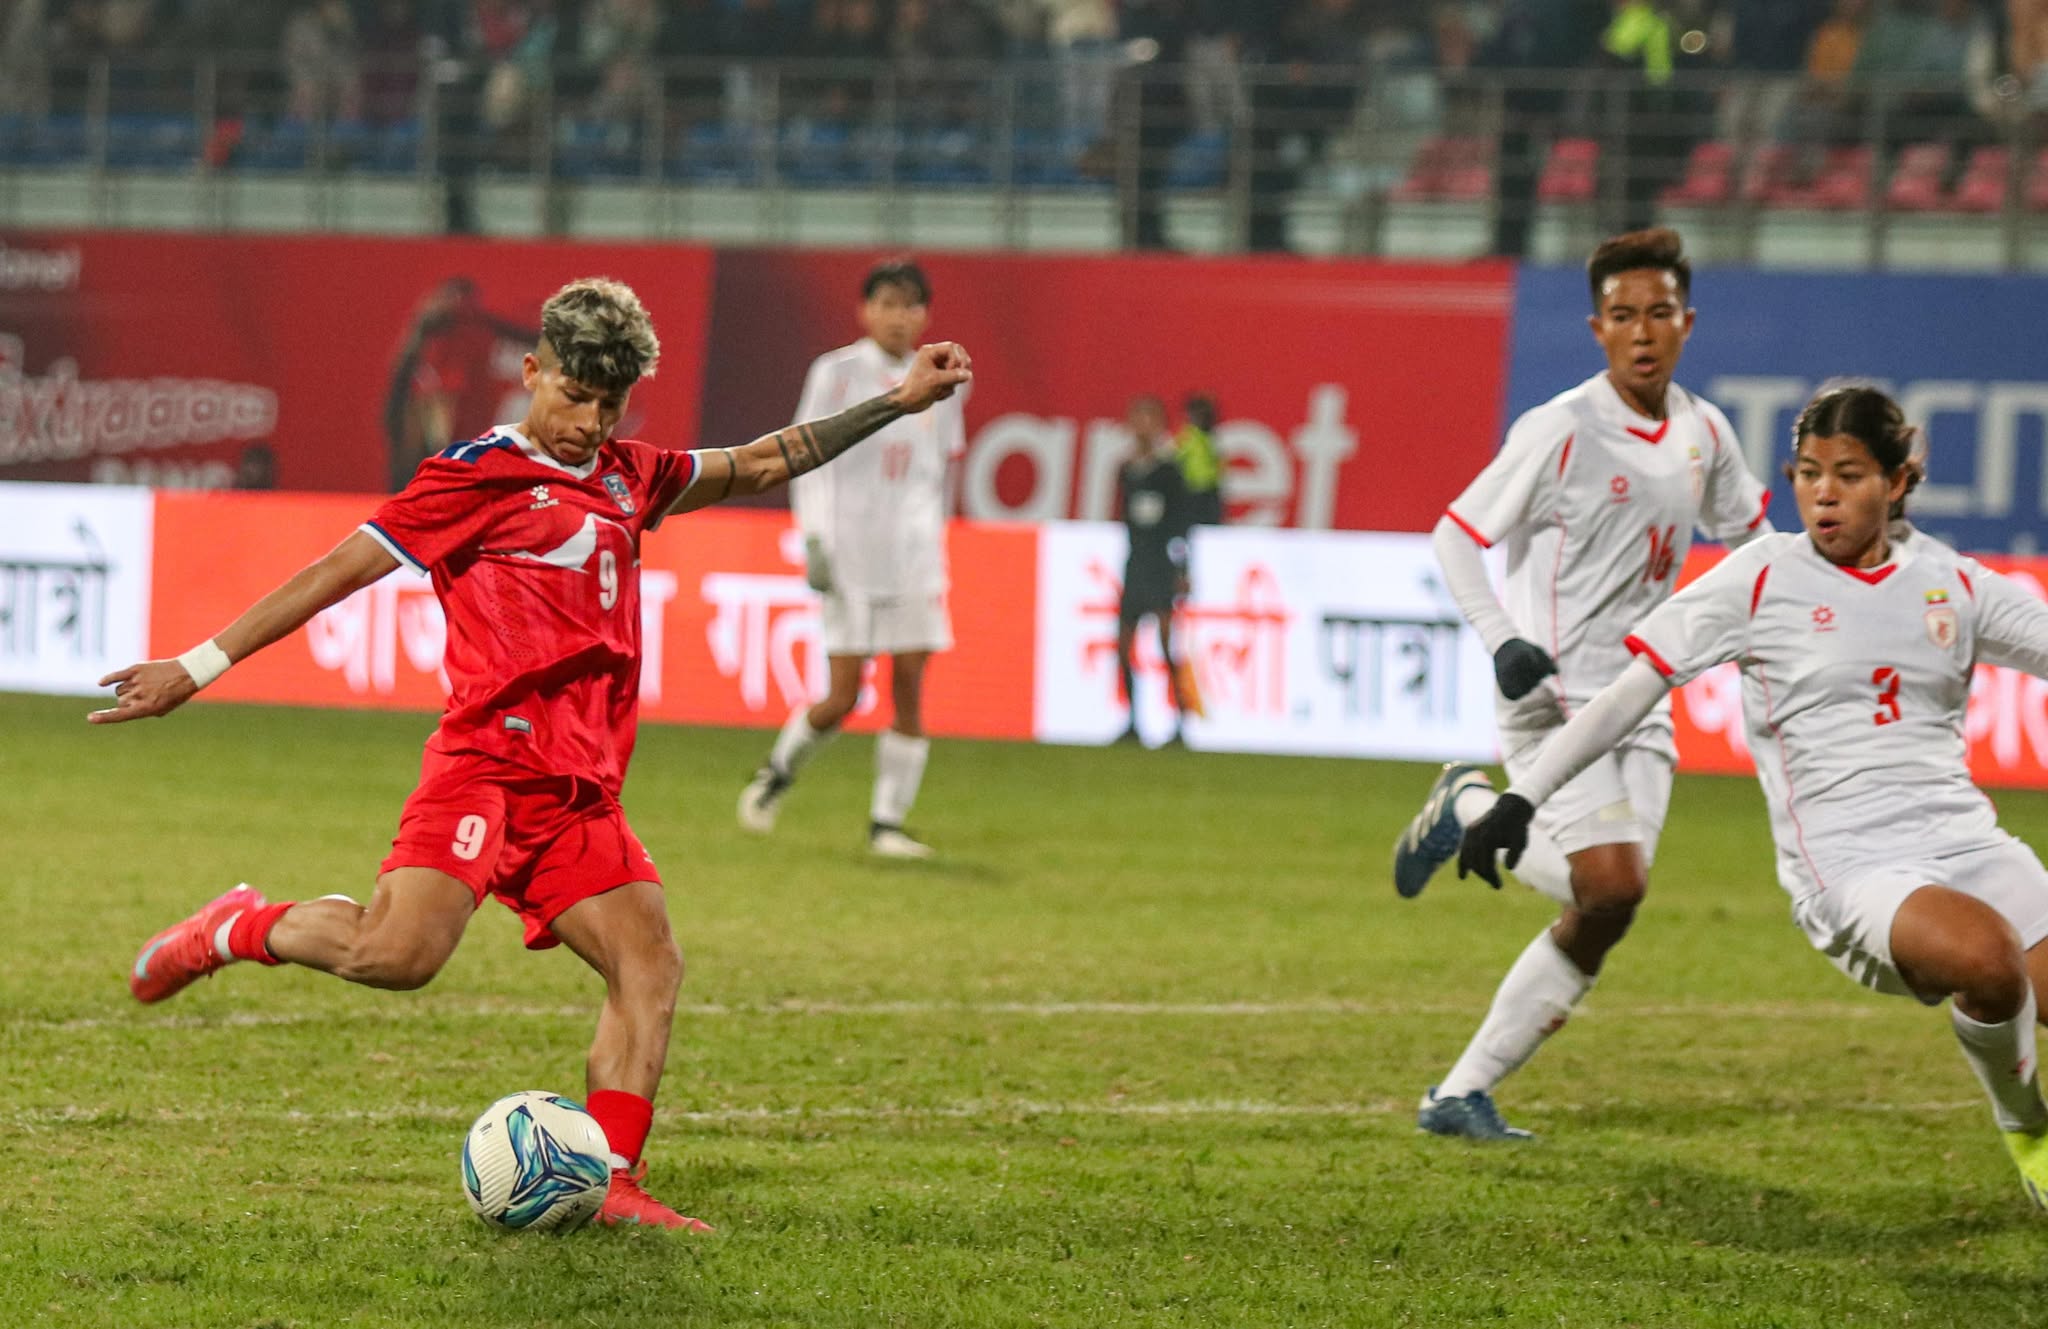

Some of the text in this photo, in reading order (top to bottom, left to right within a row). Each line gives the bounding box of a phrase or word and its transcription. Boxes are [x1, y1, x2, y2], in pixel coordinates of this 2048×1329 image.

[598, 550, 619, 611] 9
[1641, 524, 1676, 584] 16
[1871, 666, 1902, 726] 3
[451, 814, 488, 861] 9
